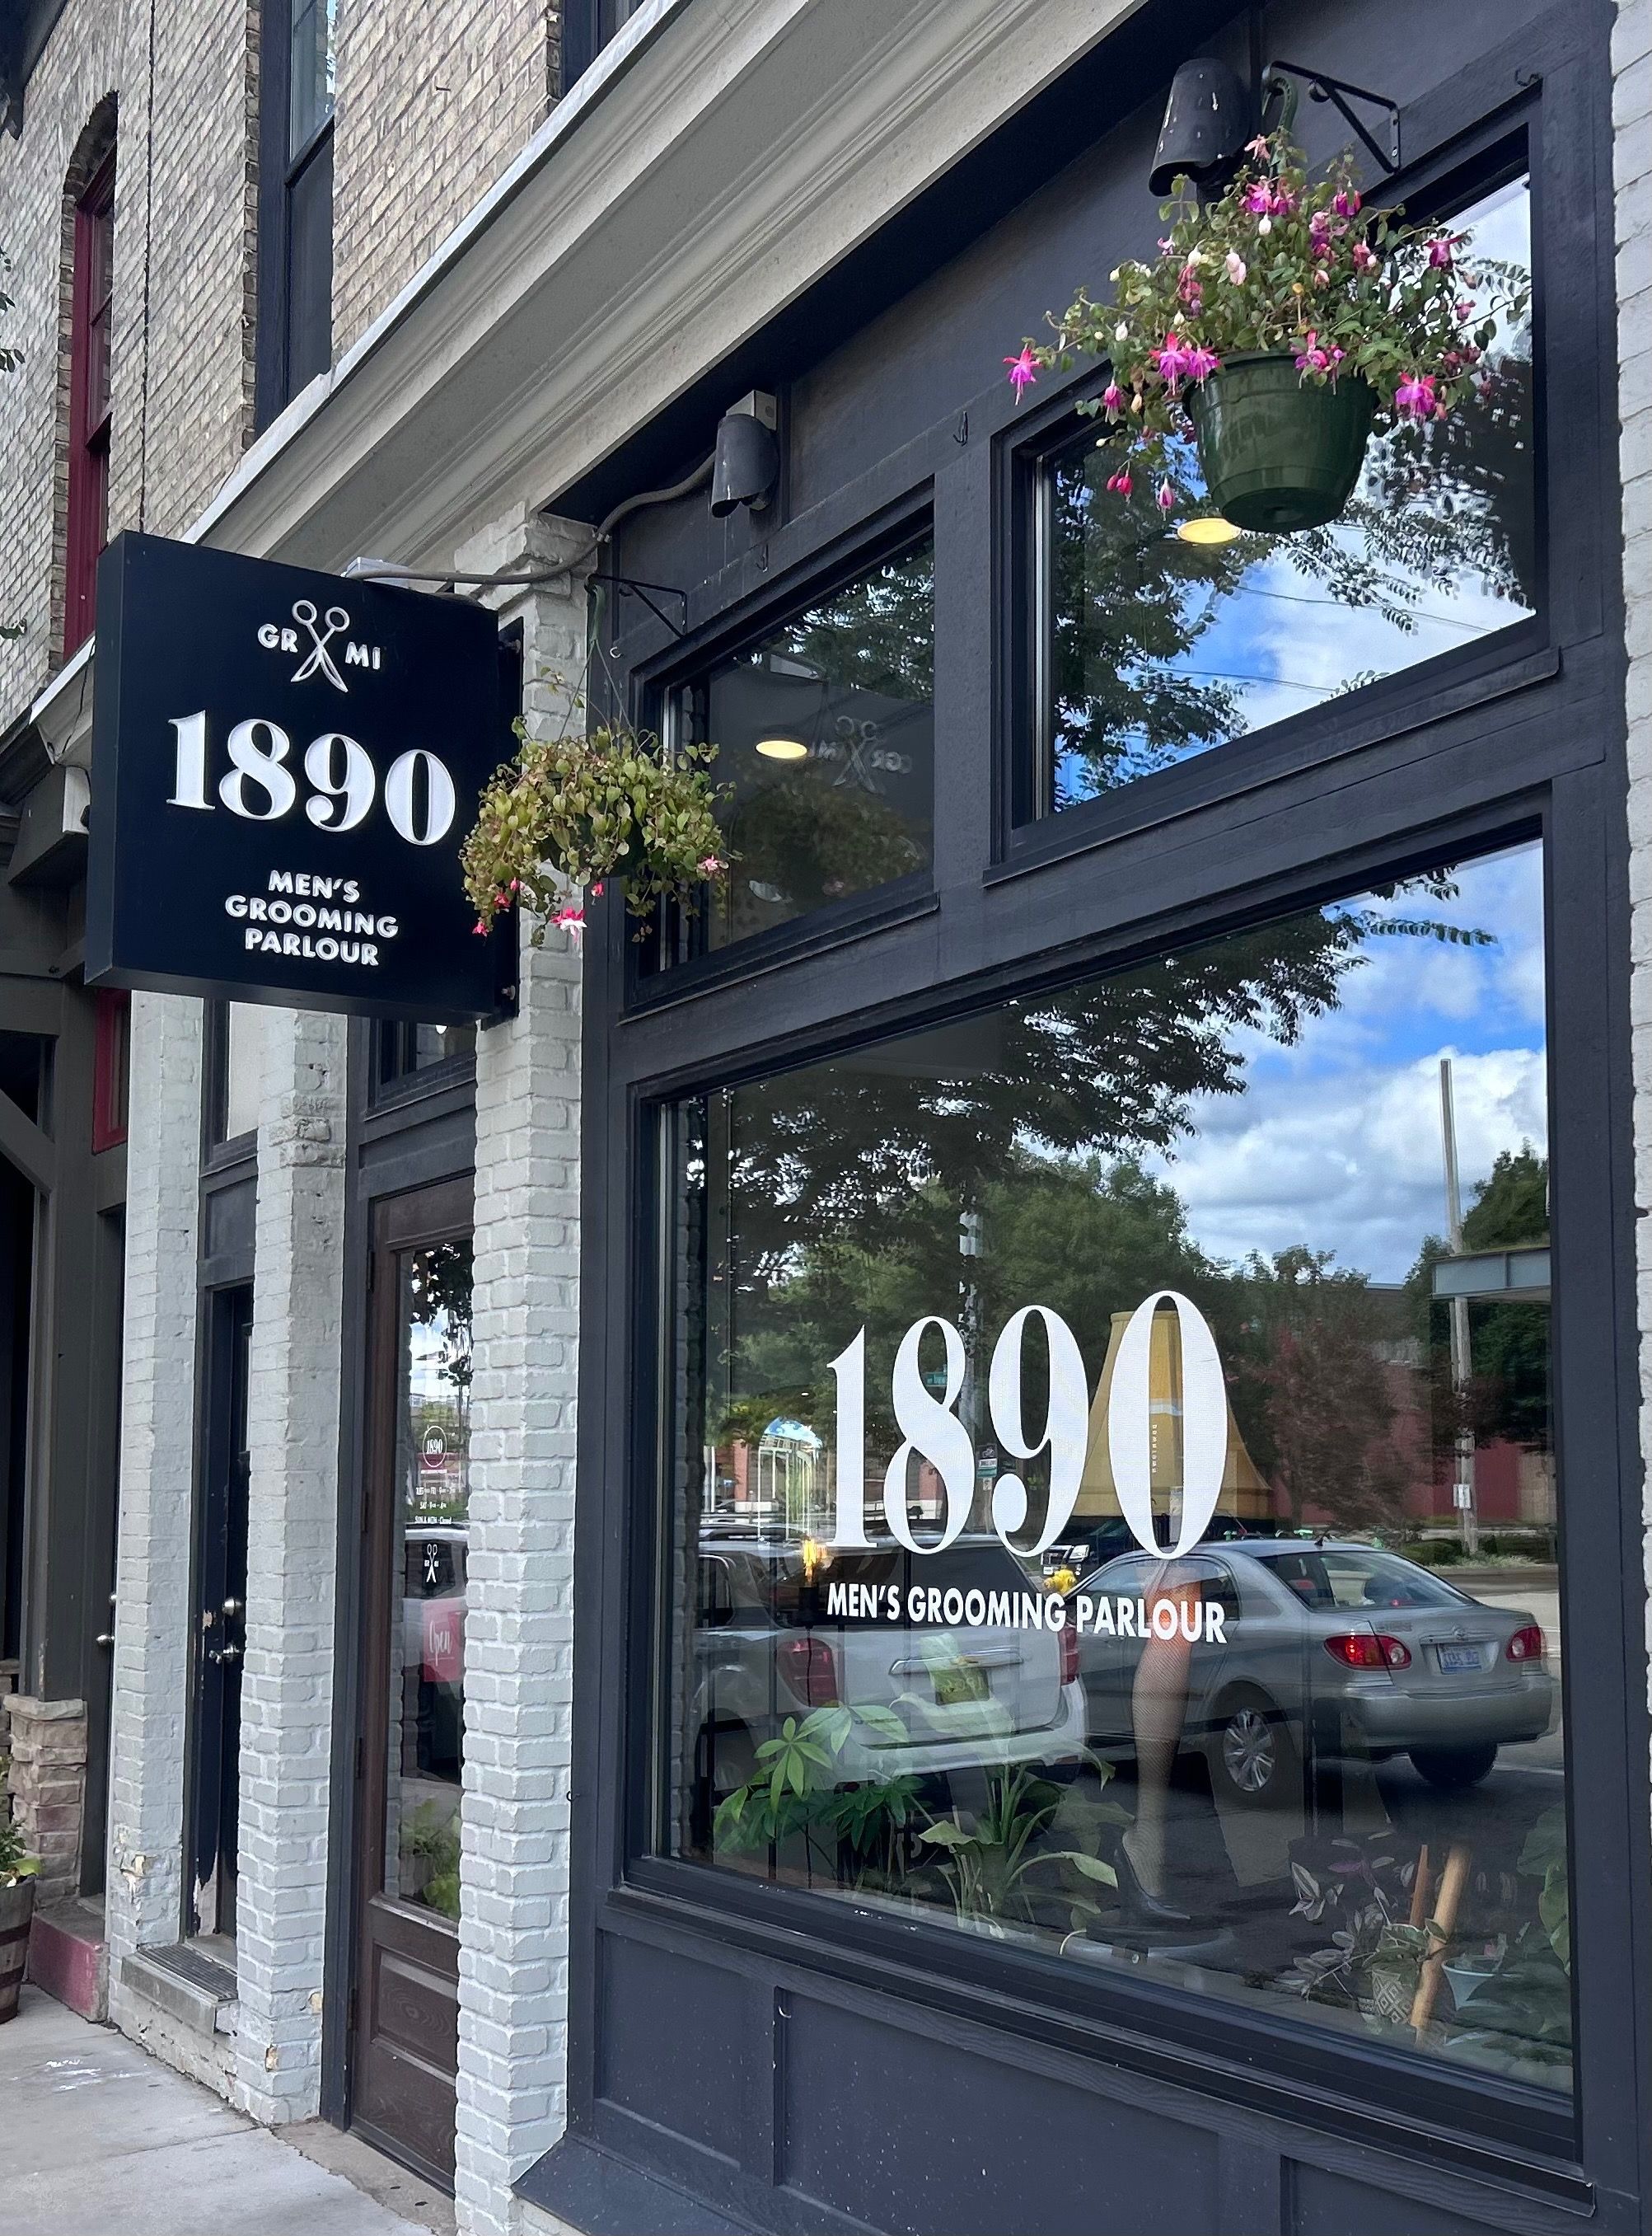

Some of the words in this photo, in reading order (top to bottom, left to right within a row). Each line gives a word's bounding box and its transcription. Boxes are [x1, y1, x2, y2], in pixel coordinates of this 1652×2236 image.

[257, 623, 298, 653] GR
[345, 641, 381, 669] MI
[166, 710, 455, 846] 1890
[268, 870, 360, 903] MEN'S
[225, 894, 399, 938] GROOMING
[245, 927, 379, 966] PARLOUR
[826, 1290, 1228, 1559] 1890
[826, 1582, 901, 1620] MEN'S
[907, 1588, 1067, 1631] GROOMING
[1076, 1595, 1228, 1643] PARLOUR
[429, 1620, 452, 1667] Open
